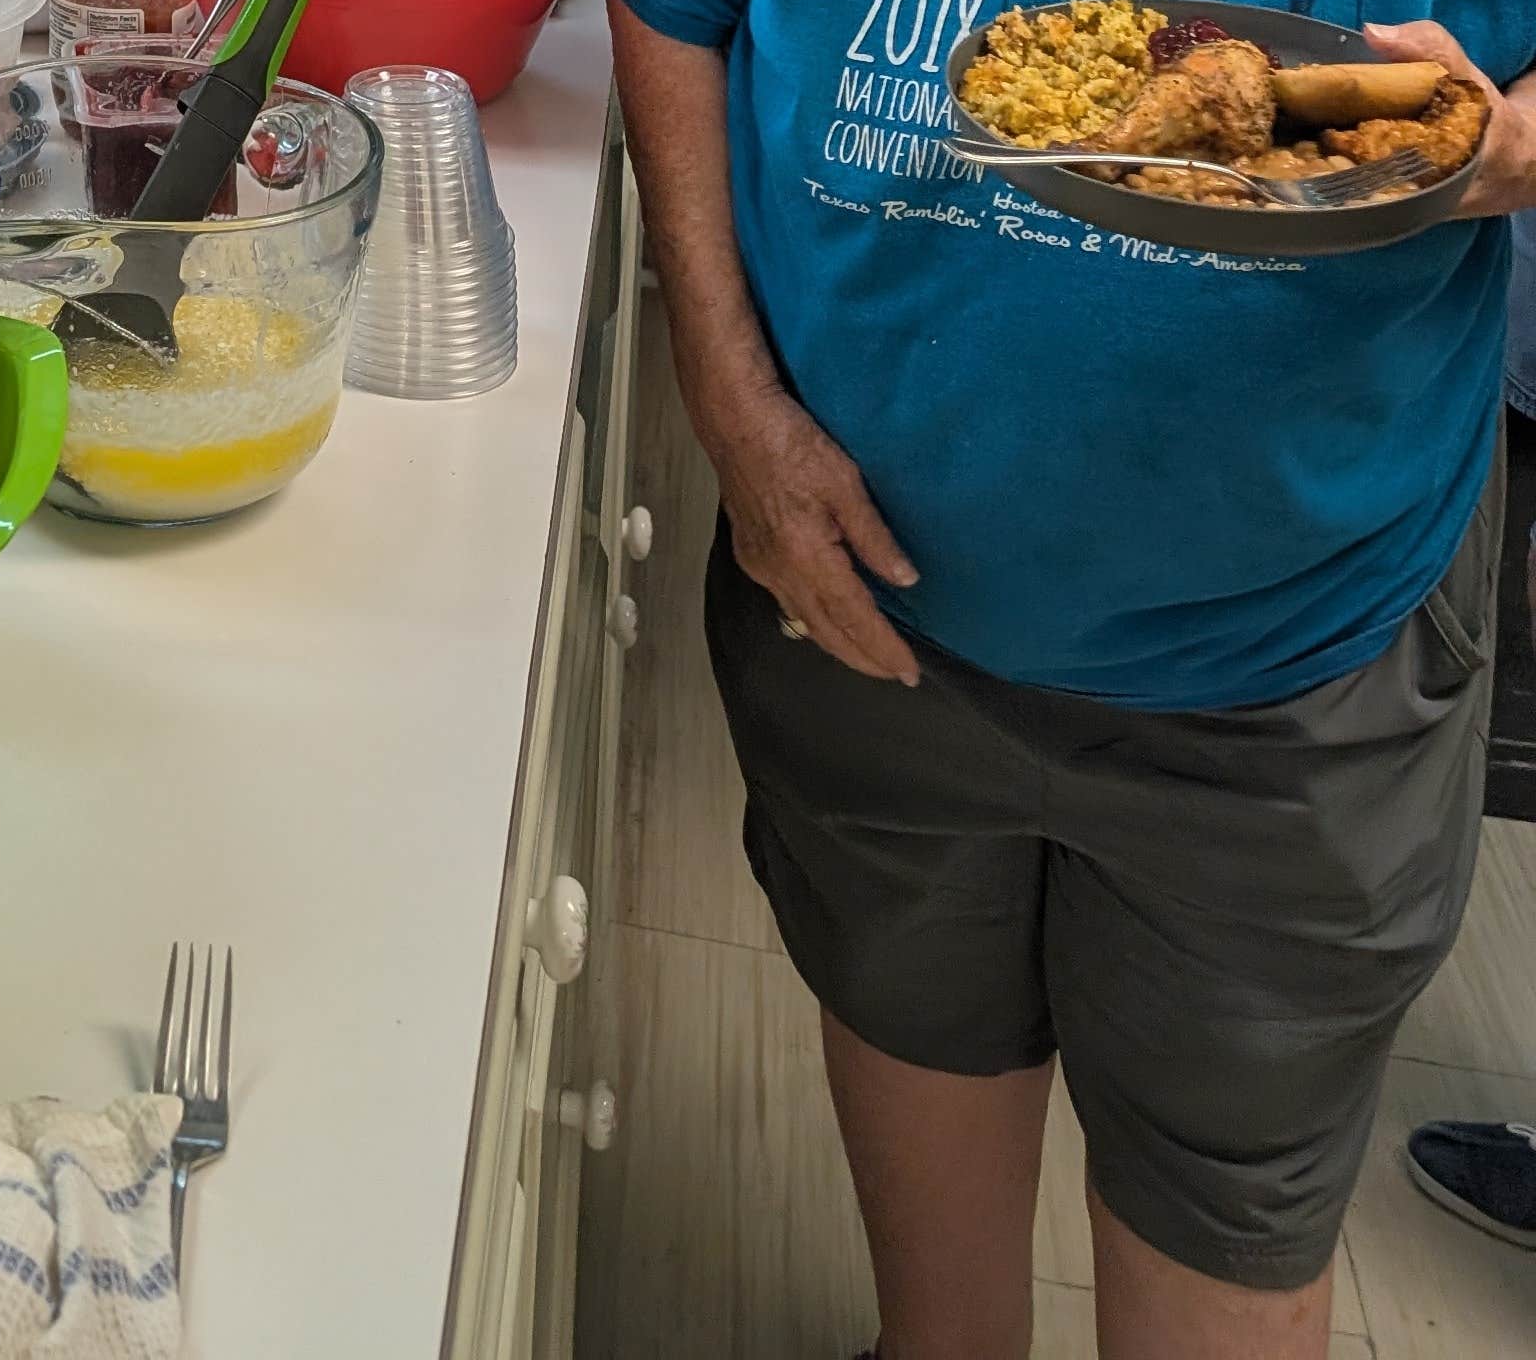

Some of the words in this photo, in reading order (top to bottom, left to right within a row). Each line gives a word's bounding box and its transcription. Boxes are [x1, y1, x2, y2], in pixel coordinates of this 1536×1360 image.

[836, 67, 962, 132] NATIONA
[802, 176, 870, 214] Texas
[994, 214, 1072, 251] Roses
[1080, 233, 1102, 254] &
[1108, 232, 1307, 274] Mid-America
